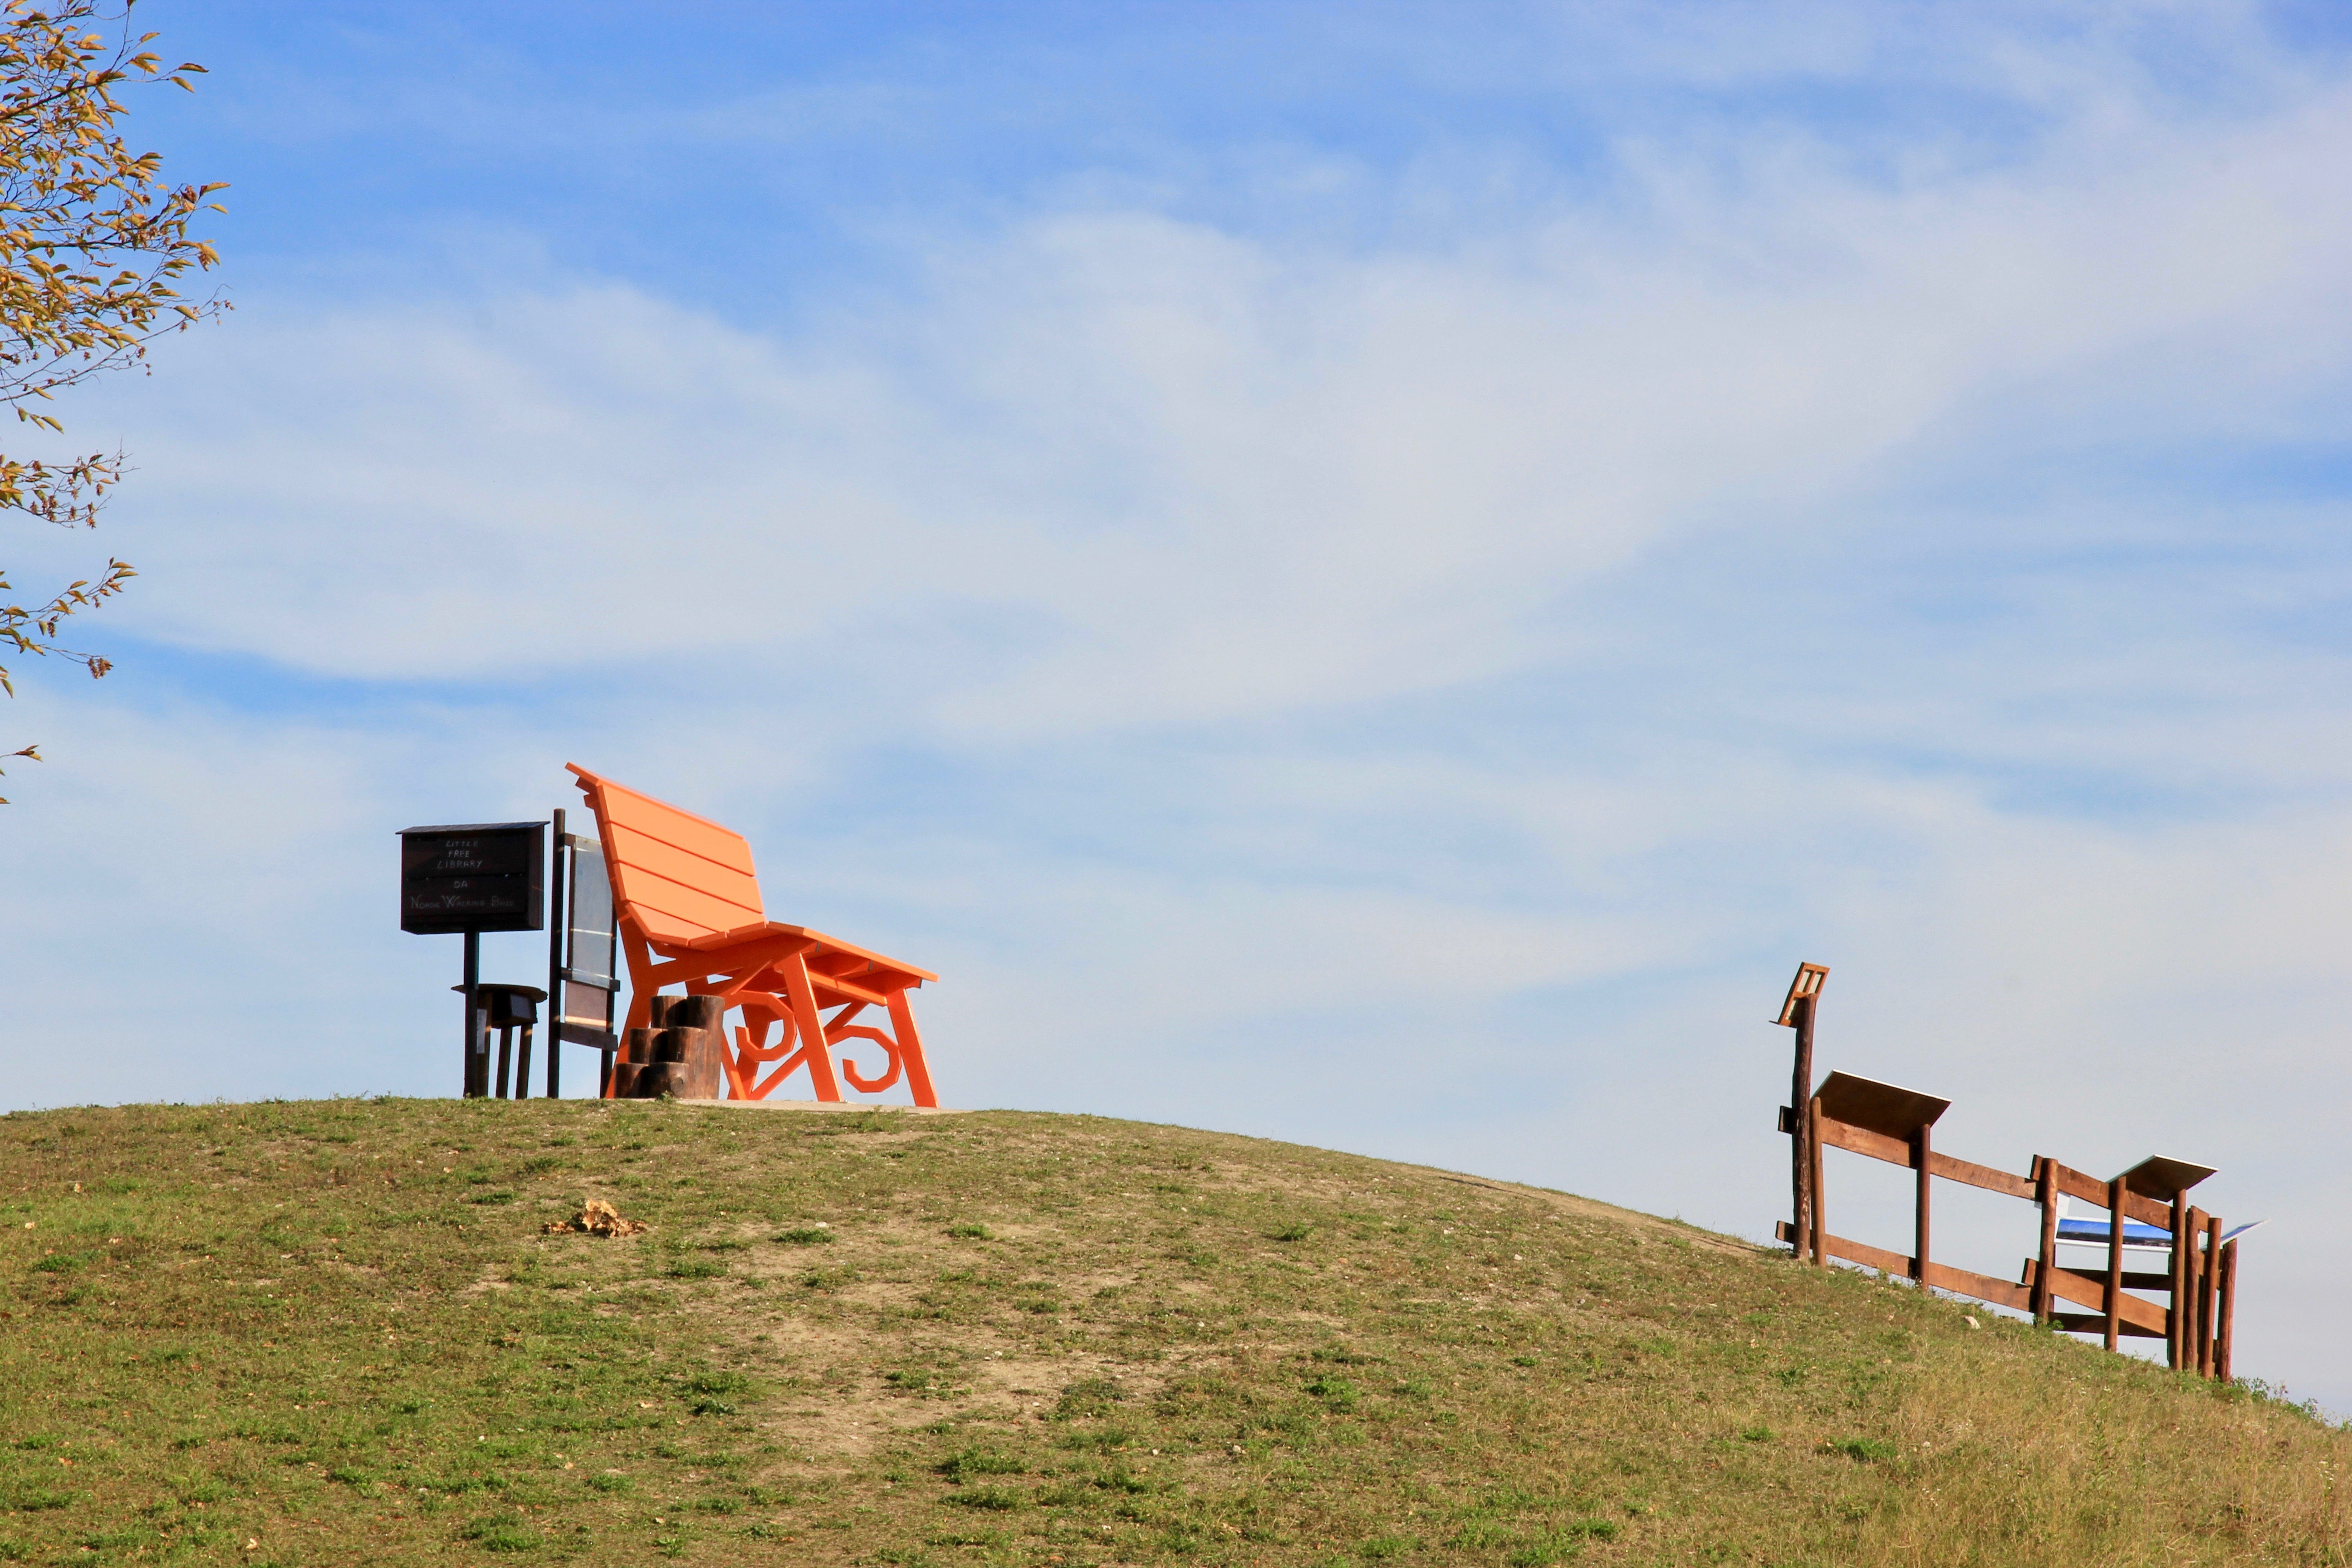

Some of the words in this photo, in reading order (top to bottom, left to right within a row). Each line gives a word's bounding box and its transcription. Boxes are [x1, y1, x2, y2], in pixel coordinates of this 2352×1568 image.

[448, 849, 470, 858] FREE
[437, 860, 483, 869] LIBRARY
[454, 880, 468, 889] DA
[441, 895, 485, 908] WALKING
